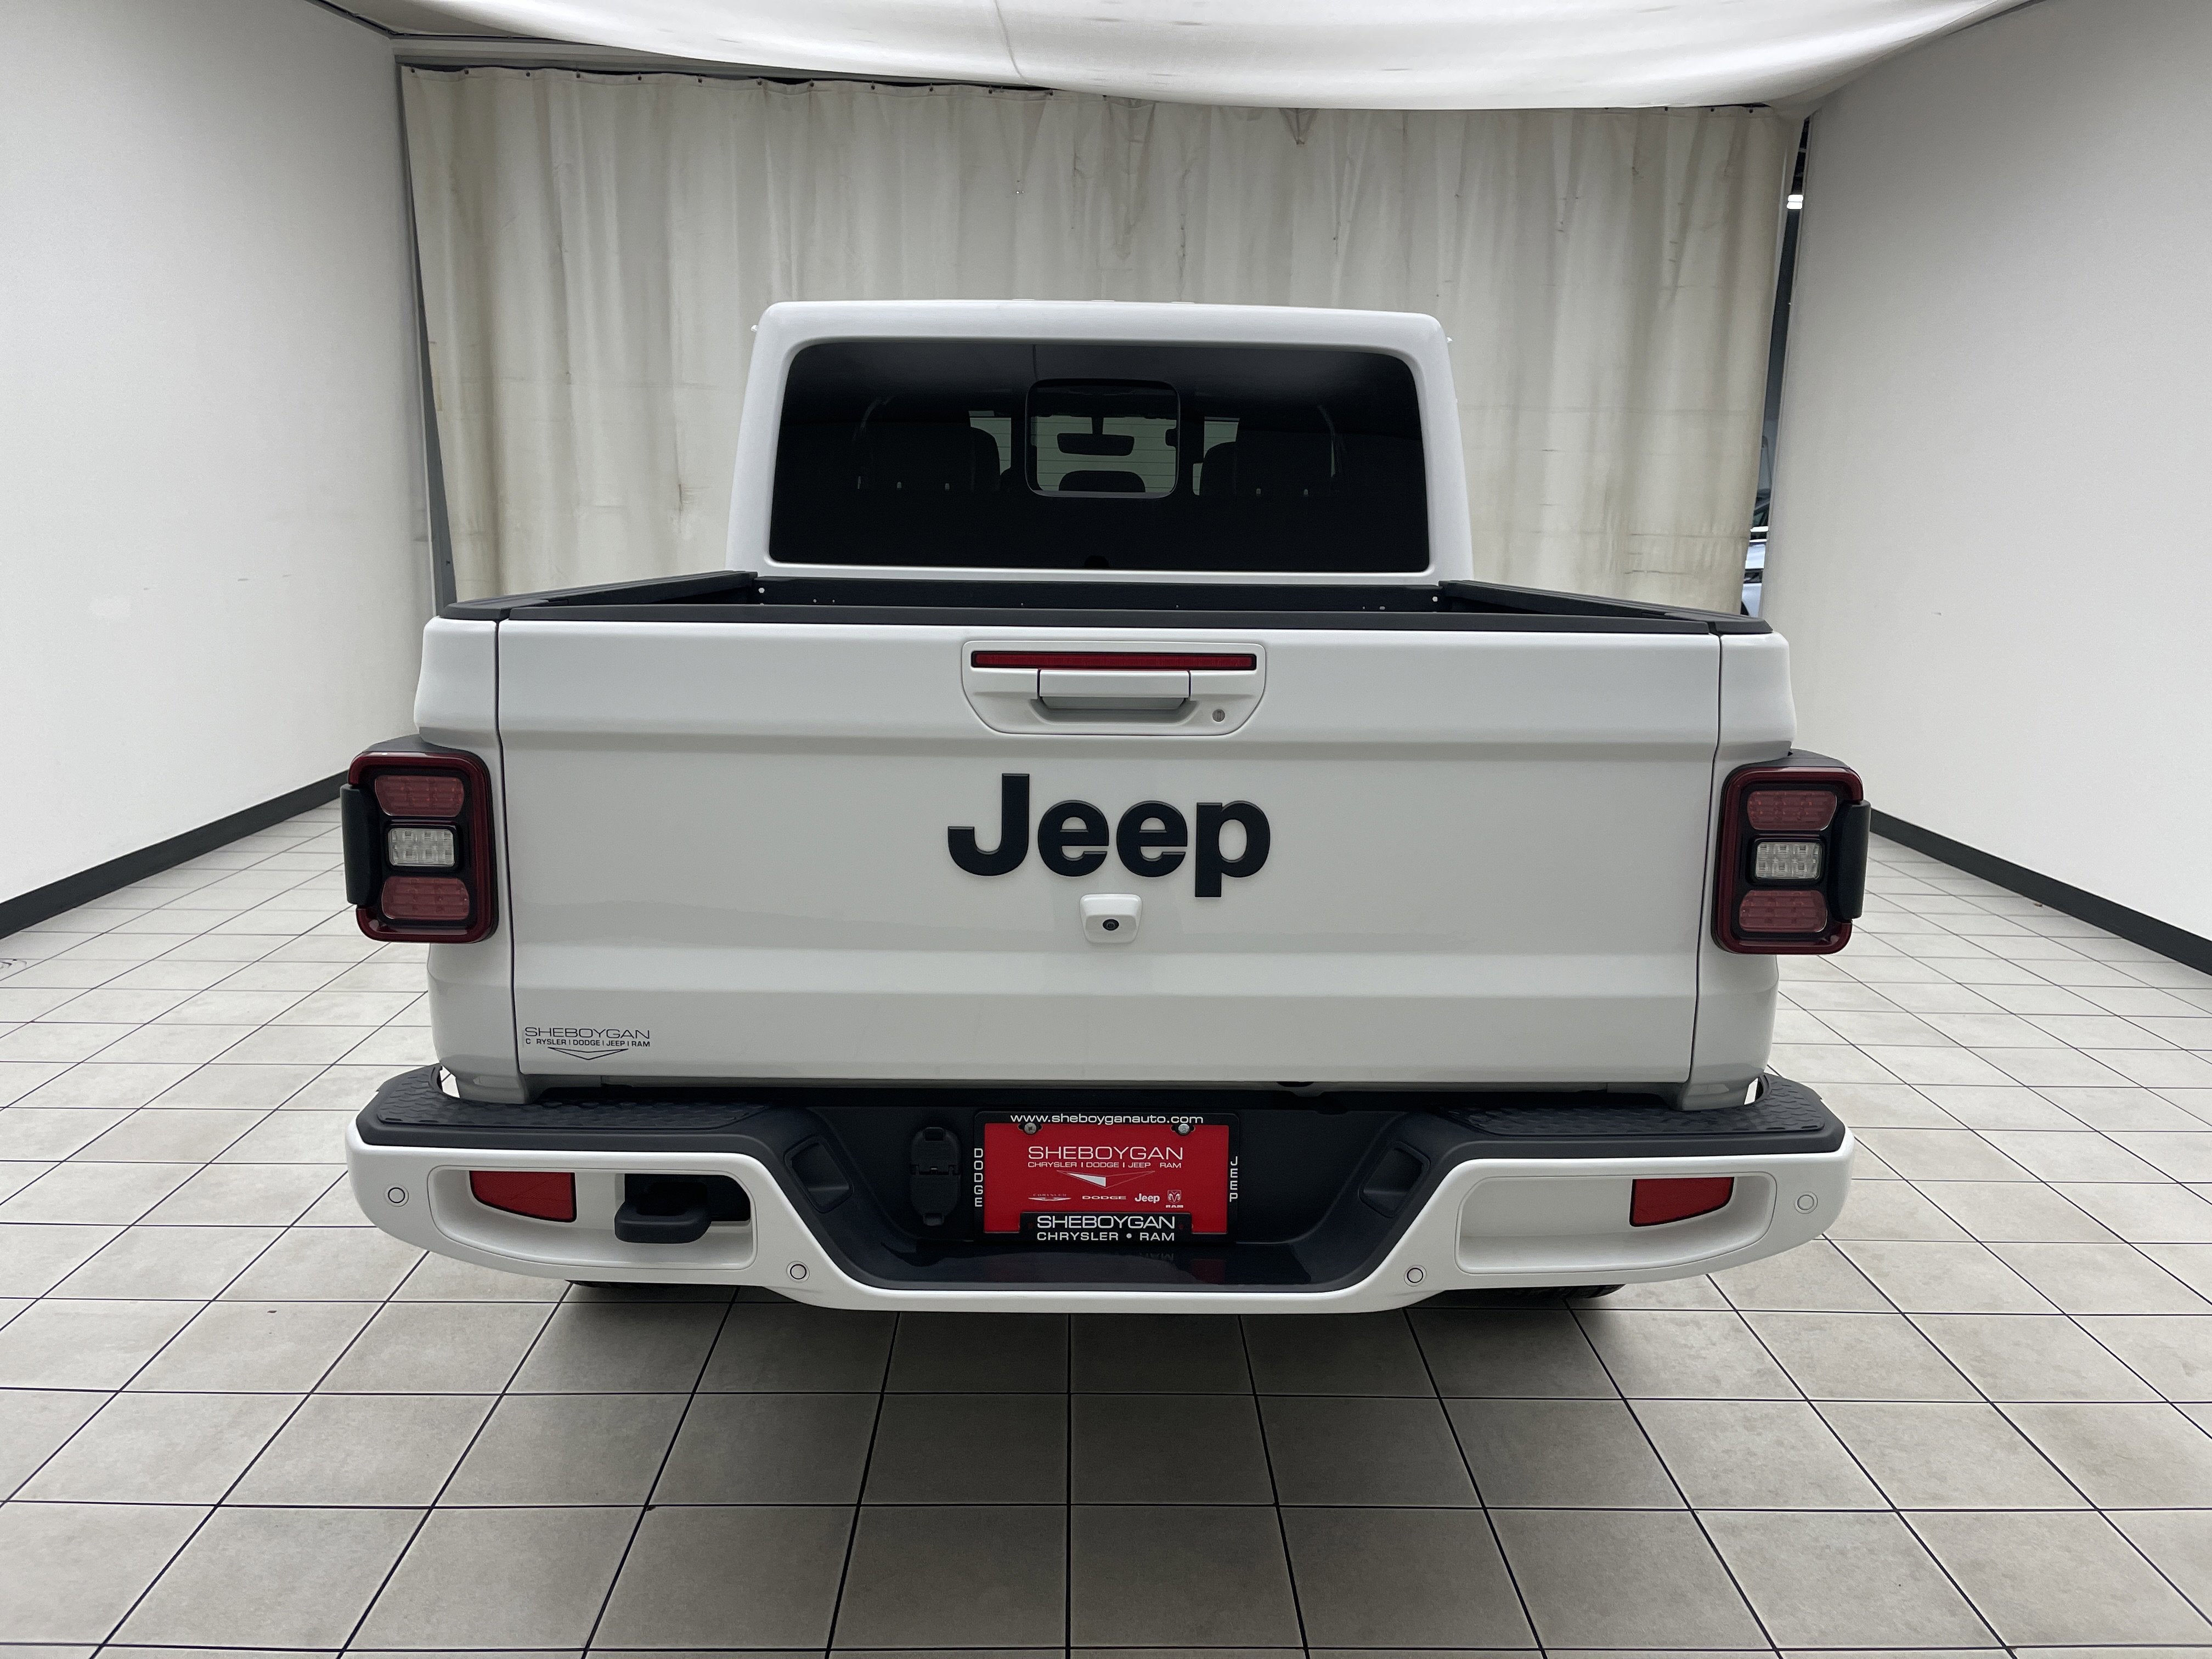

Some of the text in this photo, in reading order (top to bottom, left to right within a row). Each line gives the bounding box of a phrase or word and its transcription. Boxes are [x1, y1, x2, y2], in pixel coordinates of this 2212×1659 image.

[947, 773, 1270, 897] Jeep
[524, 1027, 650, 1039] SHEBOYGAN
[1011, 1113, 1204, 1125] www.sheboyganauto.com
[1028, 1146, 1183, 1160] SHEBOYGAN
[974, 1148, 984, 1207] DODGE
[1229, 1156, 1238, 1203] JEEP
[1135, 1193, 1160, 1203] Jeep
[1037, 1216, 1175, 1229] SHEBOYGAN
[1037, 1232, 1175, 1241] CHRYSLER RAM
